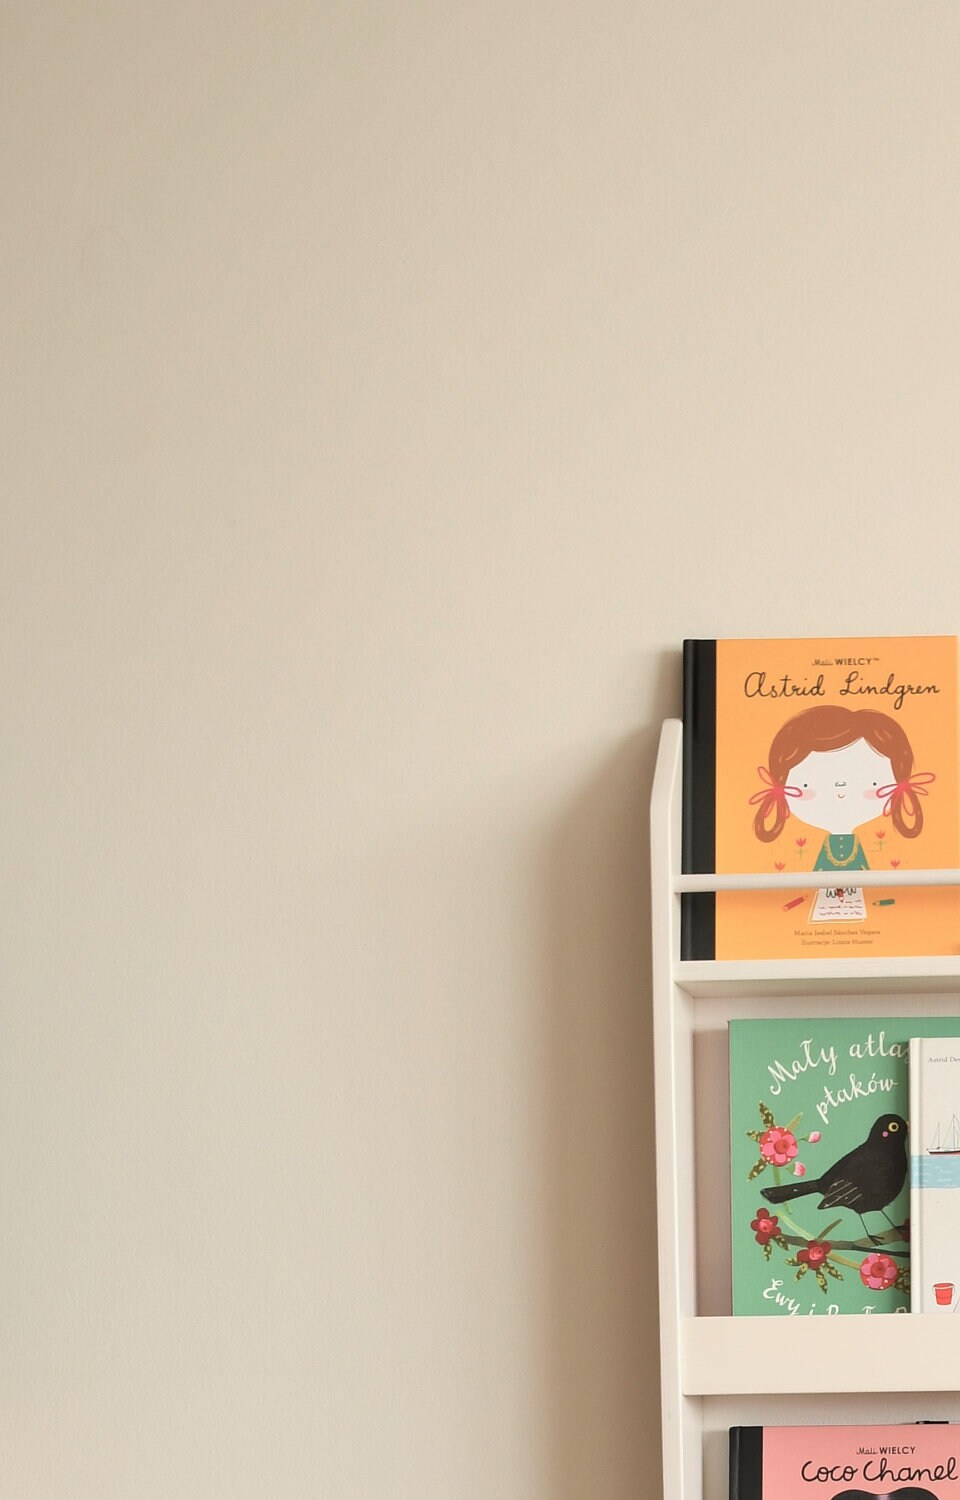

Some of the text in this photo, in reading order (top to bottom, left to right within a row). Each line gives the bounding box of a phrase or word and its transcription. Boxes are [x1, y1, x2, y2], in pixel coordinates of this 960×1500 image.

[744, 671, 940, 710] Astrid Lindgren
[767, 1038, 838, 1095] Mały
[816, 1072, 898, 1125] ptaków
[801, 1456, 959, 1482] Coco Chanel
[856, 1446, 916, 1455] Mali WIELCY
